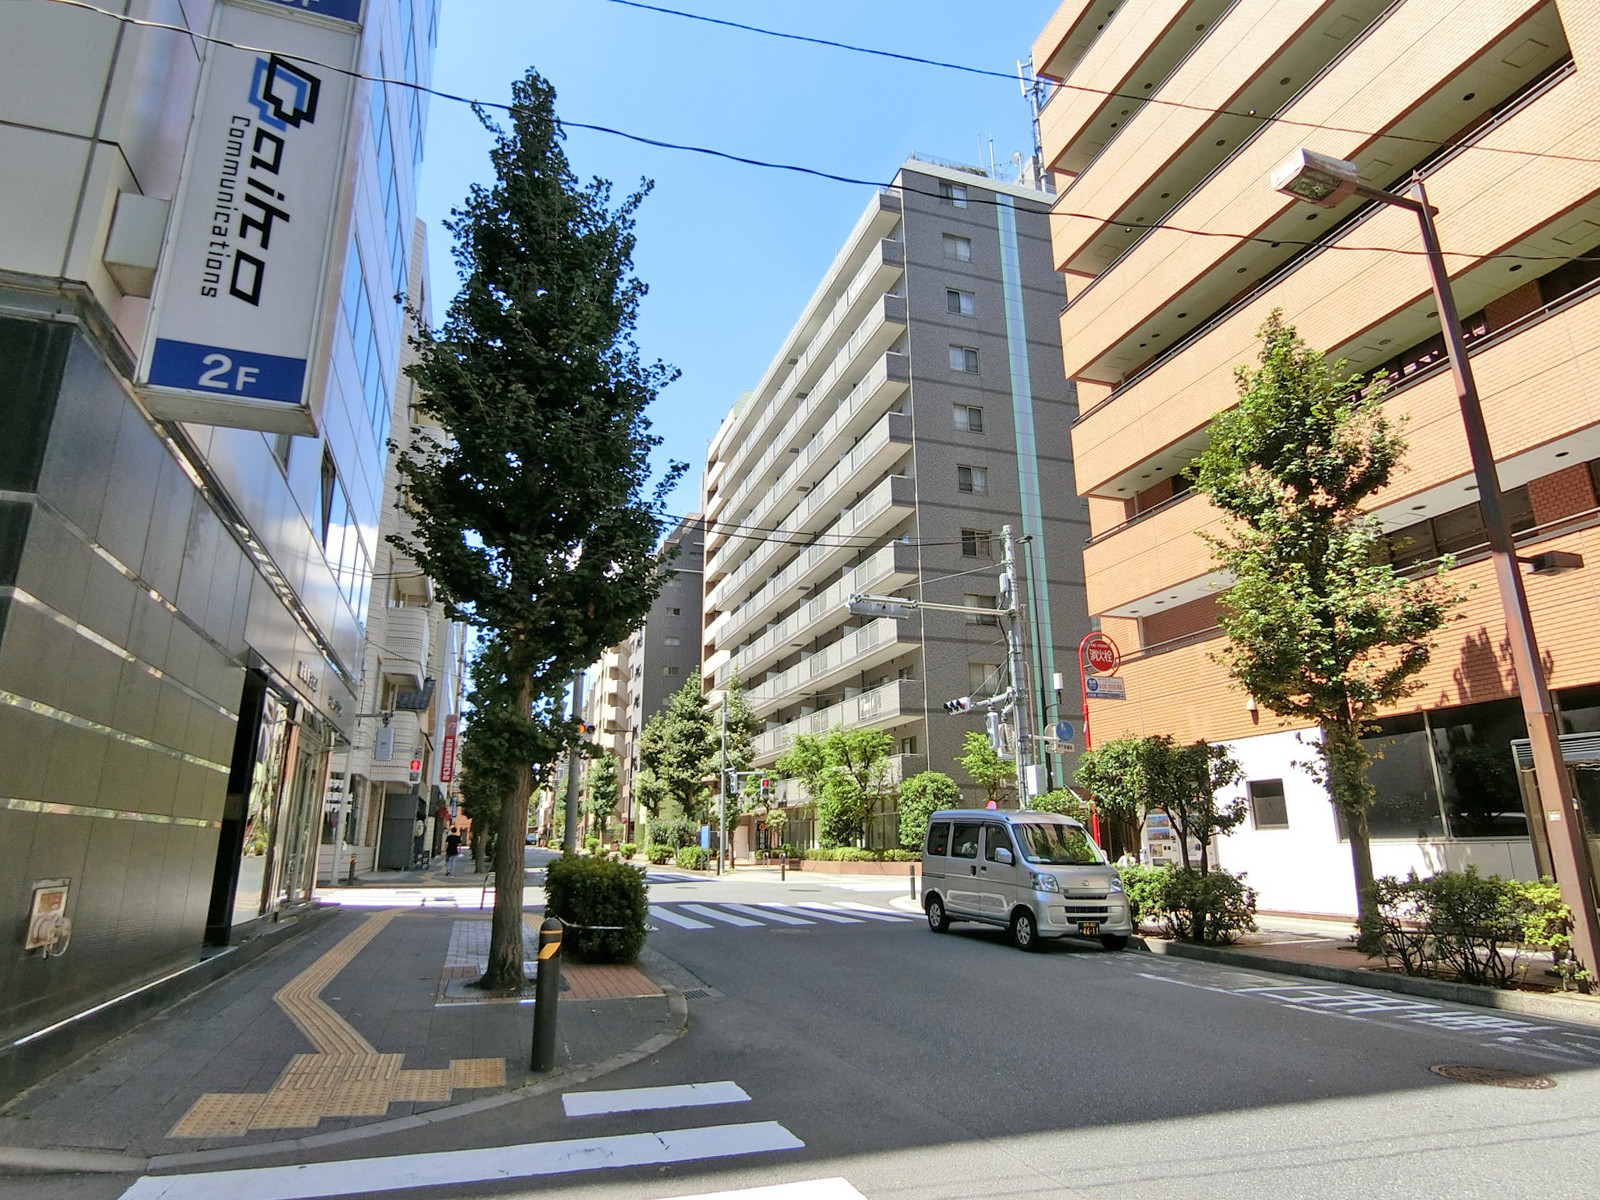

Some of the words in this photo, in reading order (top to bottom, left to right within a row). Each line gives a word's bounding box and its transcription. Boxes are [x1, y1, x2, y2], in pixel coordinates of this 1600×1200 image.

[200, 115, 251, 299] Communications
[198, 353, 260, 392] 2F
[1089, 648, 1112, 662] 消火栓
